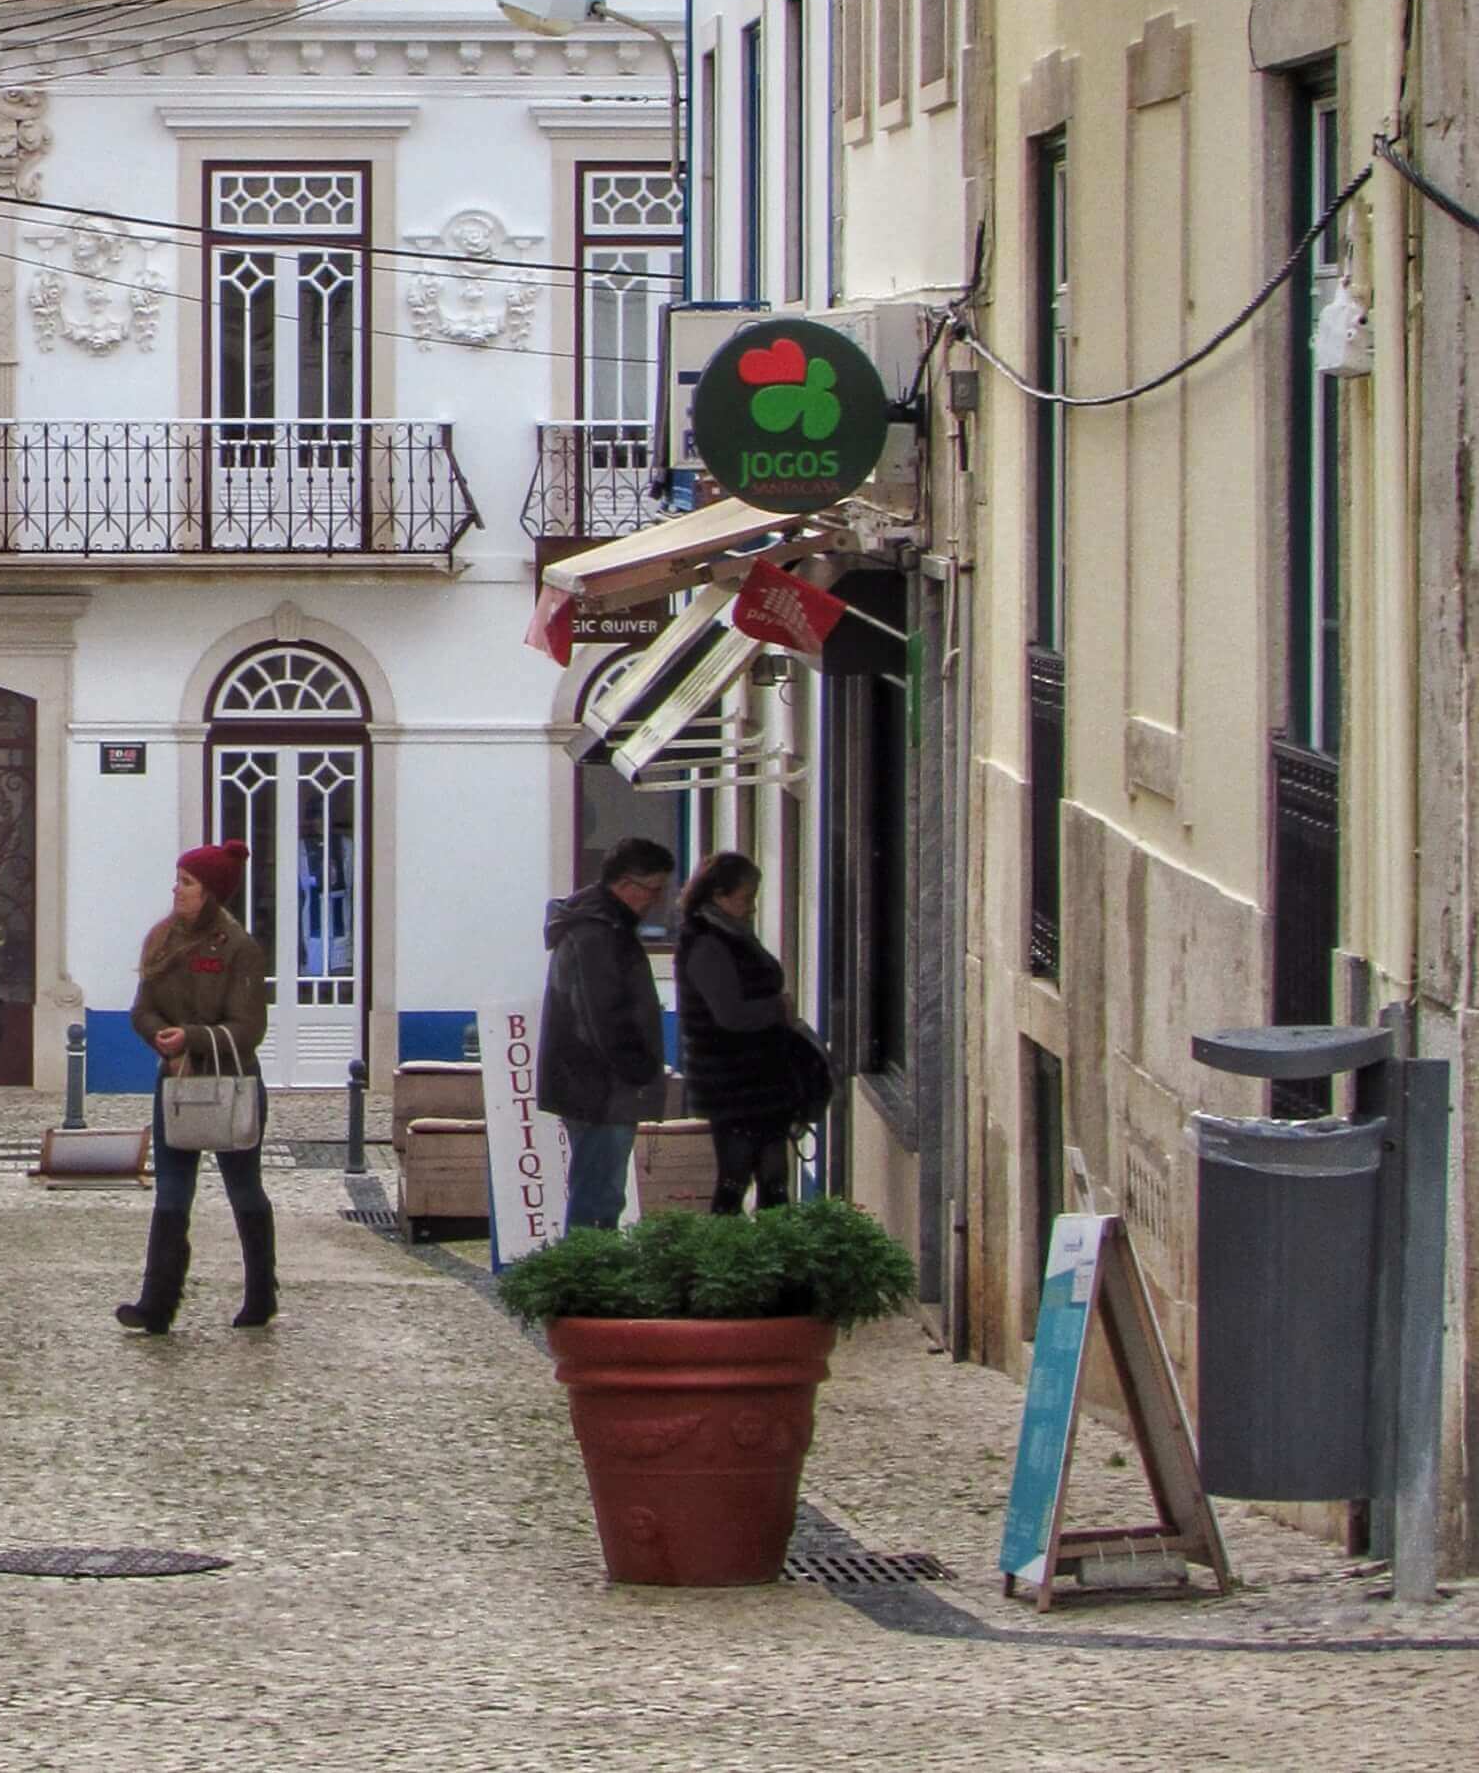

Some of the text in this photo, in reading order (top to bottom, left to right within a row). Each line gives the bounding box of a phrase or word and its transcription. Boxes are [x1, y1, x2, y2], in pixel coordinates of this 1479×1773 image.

[739, 450, 840, 489] JOGOS
[600, 619, 659, 634] QUIVER
[507, 1014, 547, 1238] BOUTIQUE
